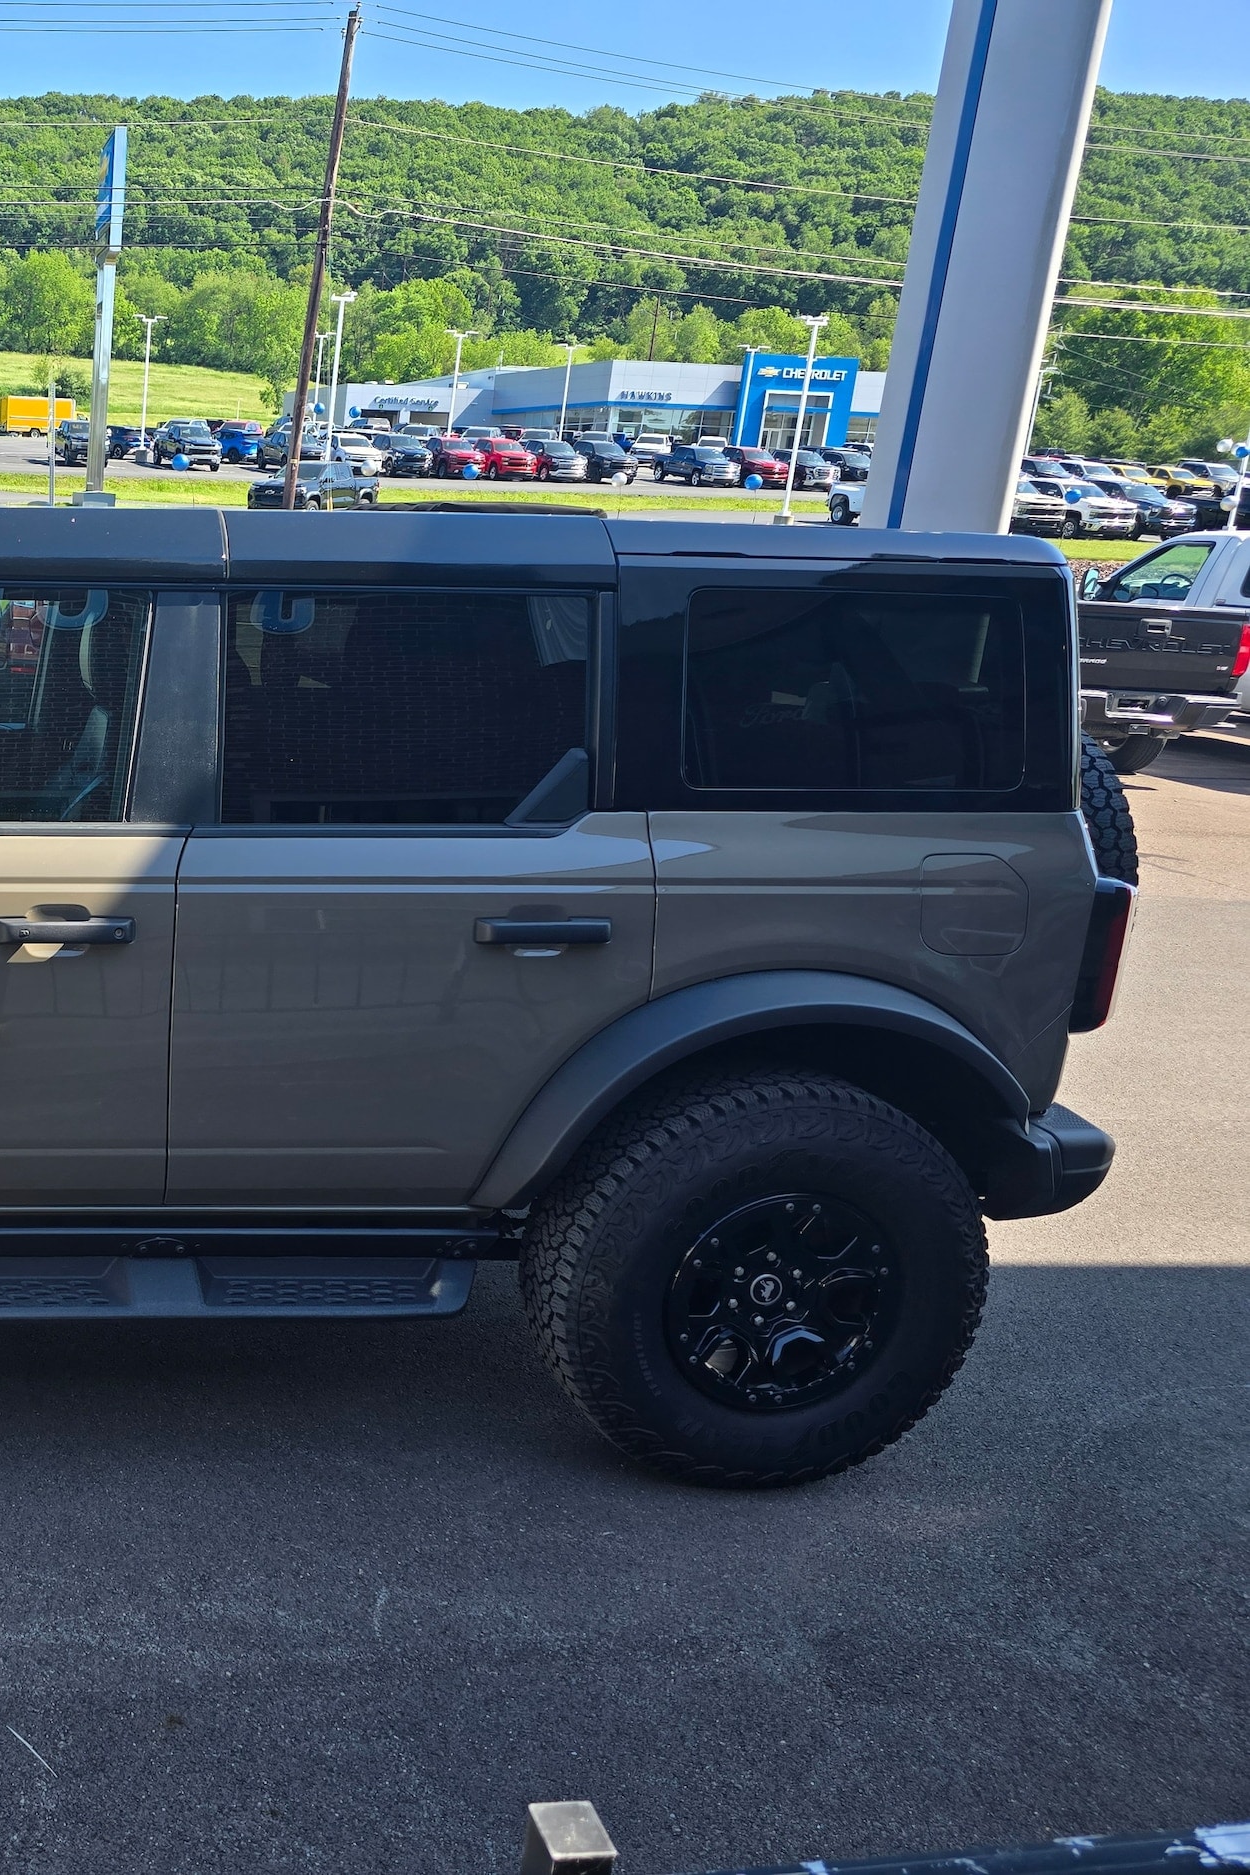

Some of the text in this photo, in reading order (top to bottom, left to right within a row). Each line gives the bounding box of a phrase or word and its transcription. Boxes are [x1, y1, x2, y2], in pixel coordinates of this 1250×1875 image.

[782, 367, 848, 381] CHEROLET
[374, 396, 439, 407] Certified Service
[619, 390, 672, 402] HAWKINS
